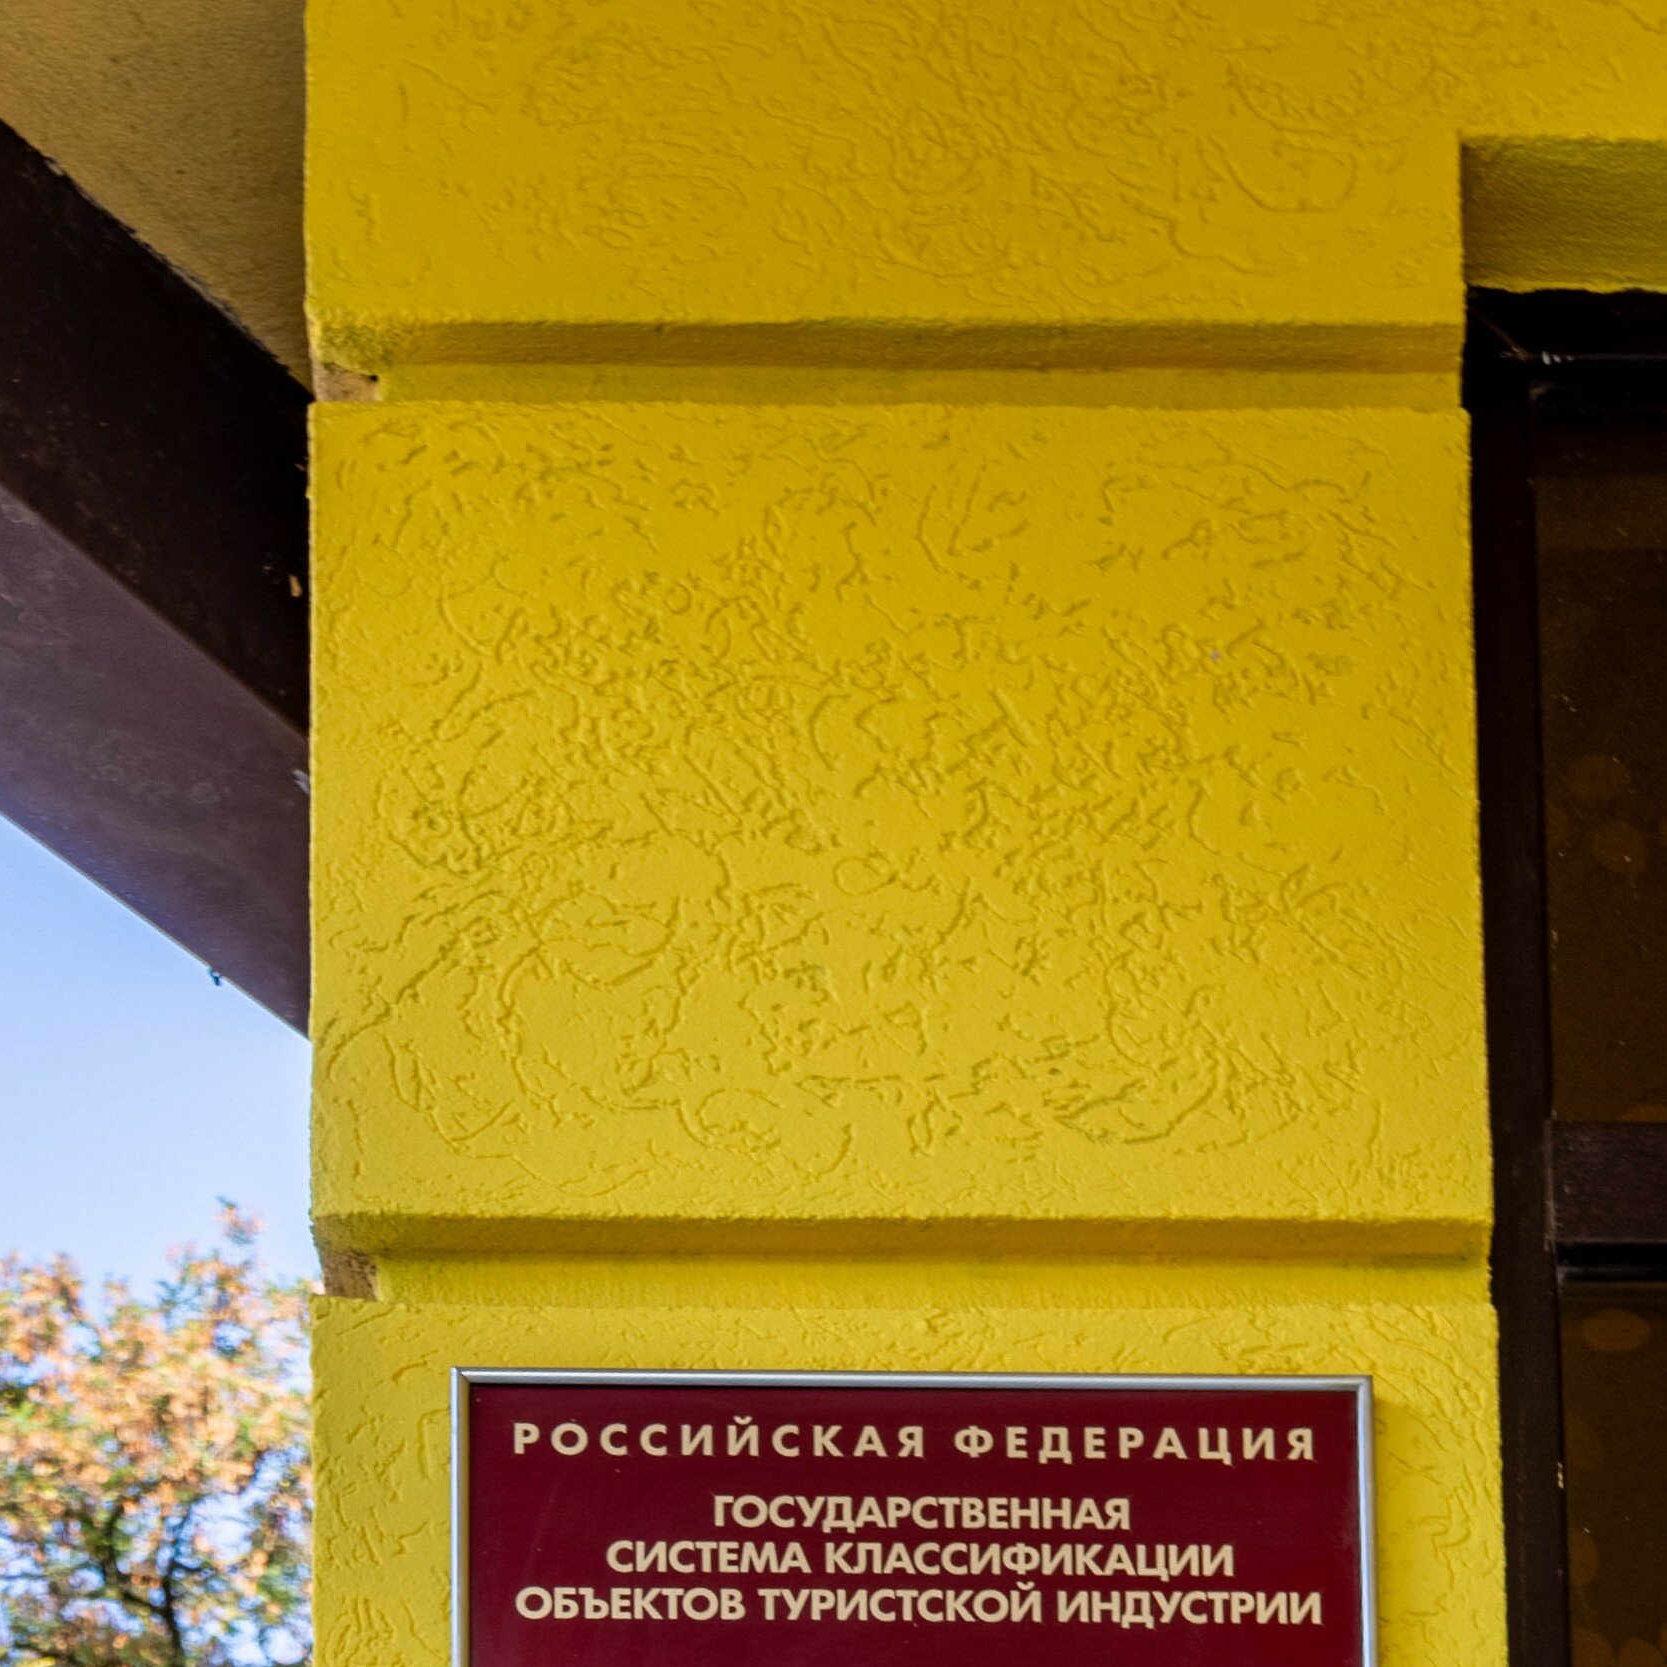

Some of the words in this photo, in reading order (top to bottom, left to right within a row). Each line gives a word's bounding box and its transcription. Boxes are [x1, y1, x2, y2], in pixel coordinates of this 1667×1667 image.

[514, 1416, 924, 1457] РОССИЙСКАЯ
[955, 1425, 1314, 1464] ФЕДЕРАЦИЯ
[714, 1495, 1130, 1533] ГОСУДАРСТВЕННАЯ
[607, 1540, 811, 1573] СИСТЕМА
[826, 1543, 1234, 1581] КЛАССИФИКАЦИИ
[515, 1586, 745, 1621] ОБЪЕКТОВ
[758, 1582, 1042, 1623] ТУРИСТСКОЙ
[1058, 1591, 1322, 1628] ИНДУСТРИИ
